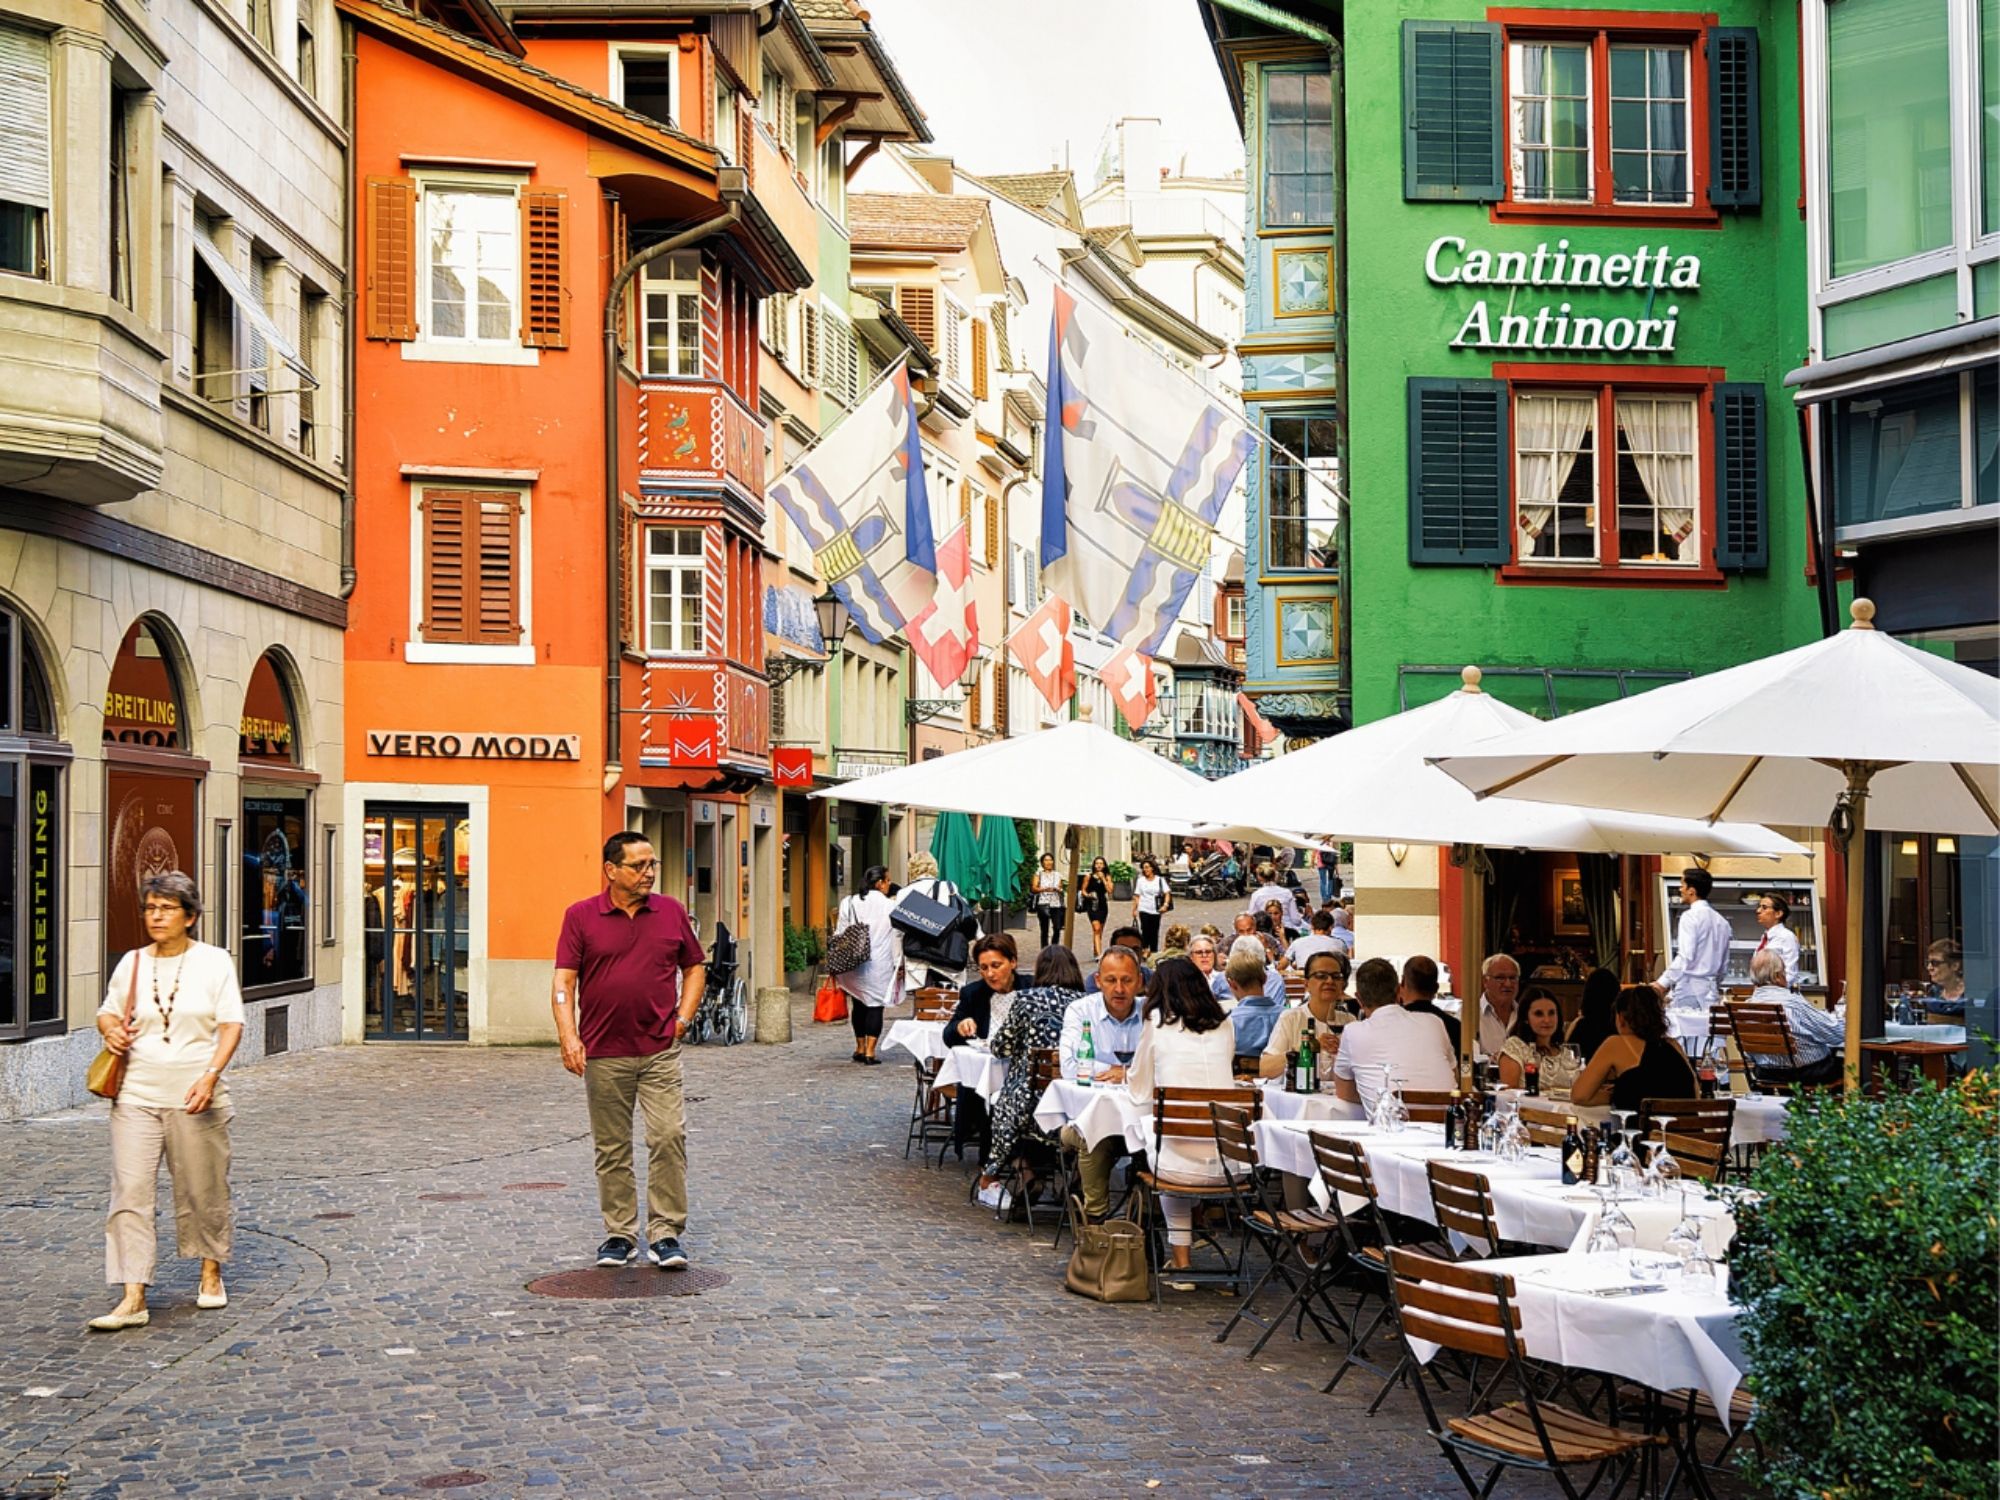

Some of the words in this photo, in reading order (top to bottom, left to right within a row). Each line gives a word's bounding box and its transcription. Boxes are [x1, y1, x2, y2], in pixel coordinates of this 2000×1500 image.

[1424, 235, 1700, 288] Cantinetta
[1448, 300, 1679, 351] Antinori
[105, 692, 176, 726] BREITLING
[240, 716, 292, 743] BREITLING
[370, 734, 461, 758] VERO
[35, 789, 48, 995] BREITLING
